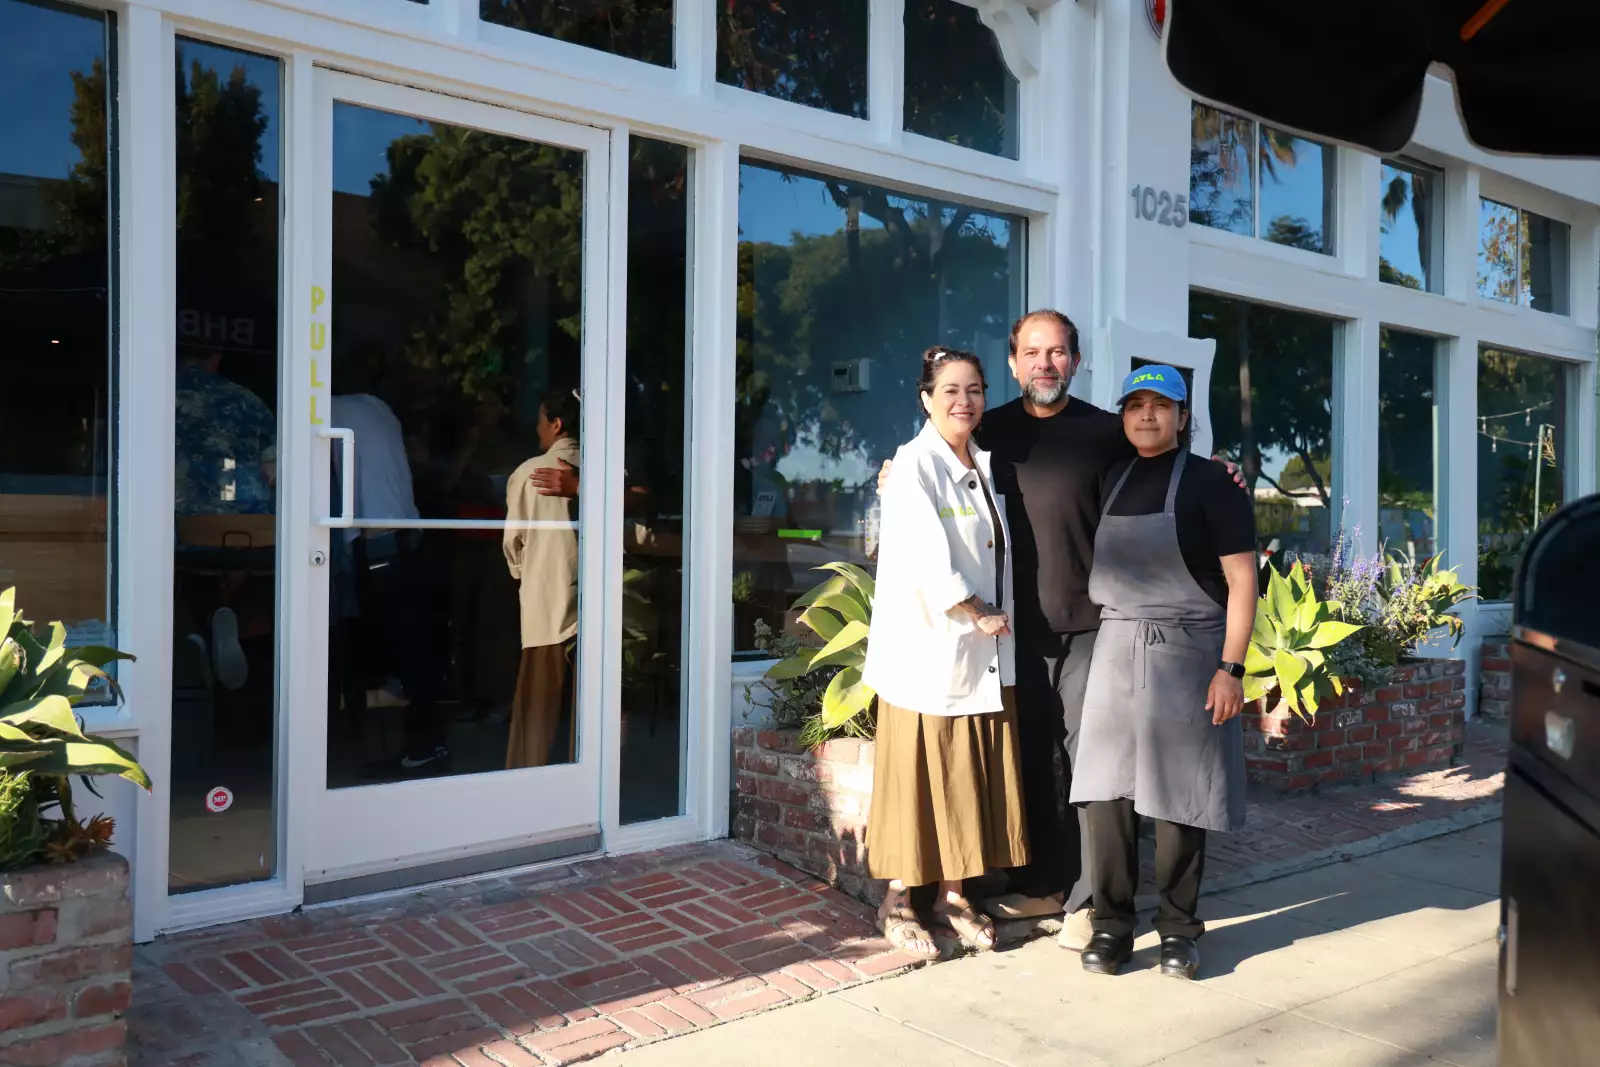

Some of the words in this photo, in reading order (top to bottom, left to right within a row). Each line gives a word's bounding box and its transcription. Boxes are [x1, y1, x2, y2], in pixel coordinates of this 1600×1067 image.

[1131, 184, 1187, 228] 1025
[310, 285, 326, 425] PULL
[1132, 373, 1164, 384] ATLA
